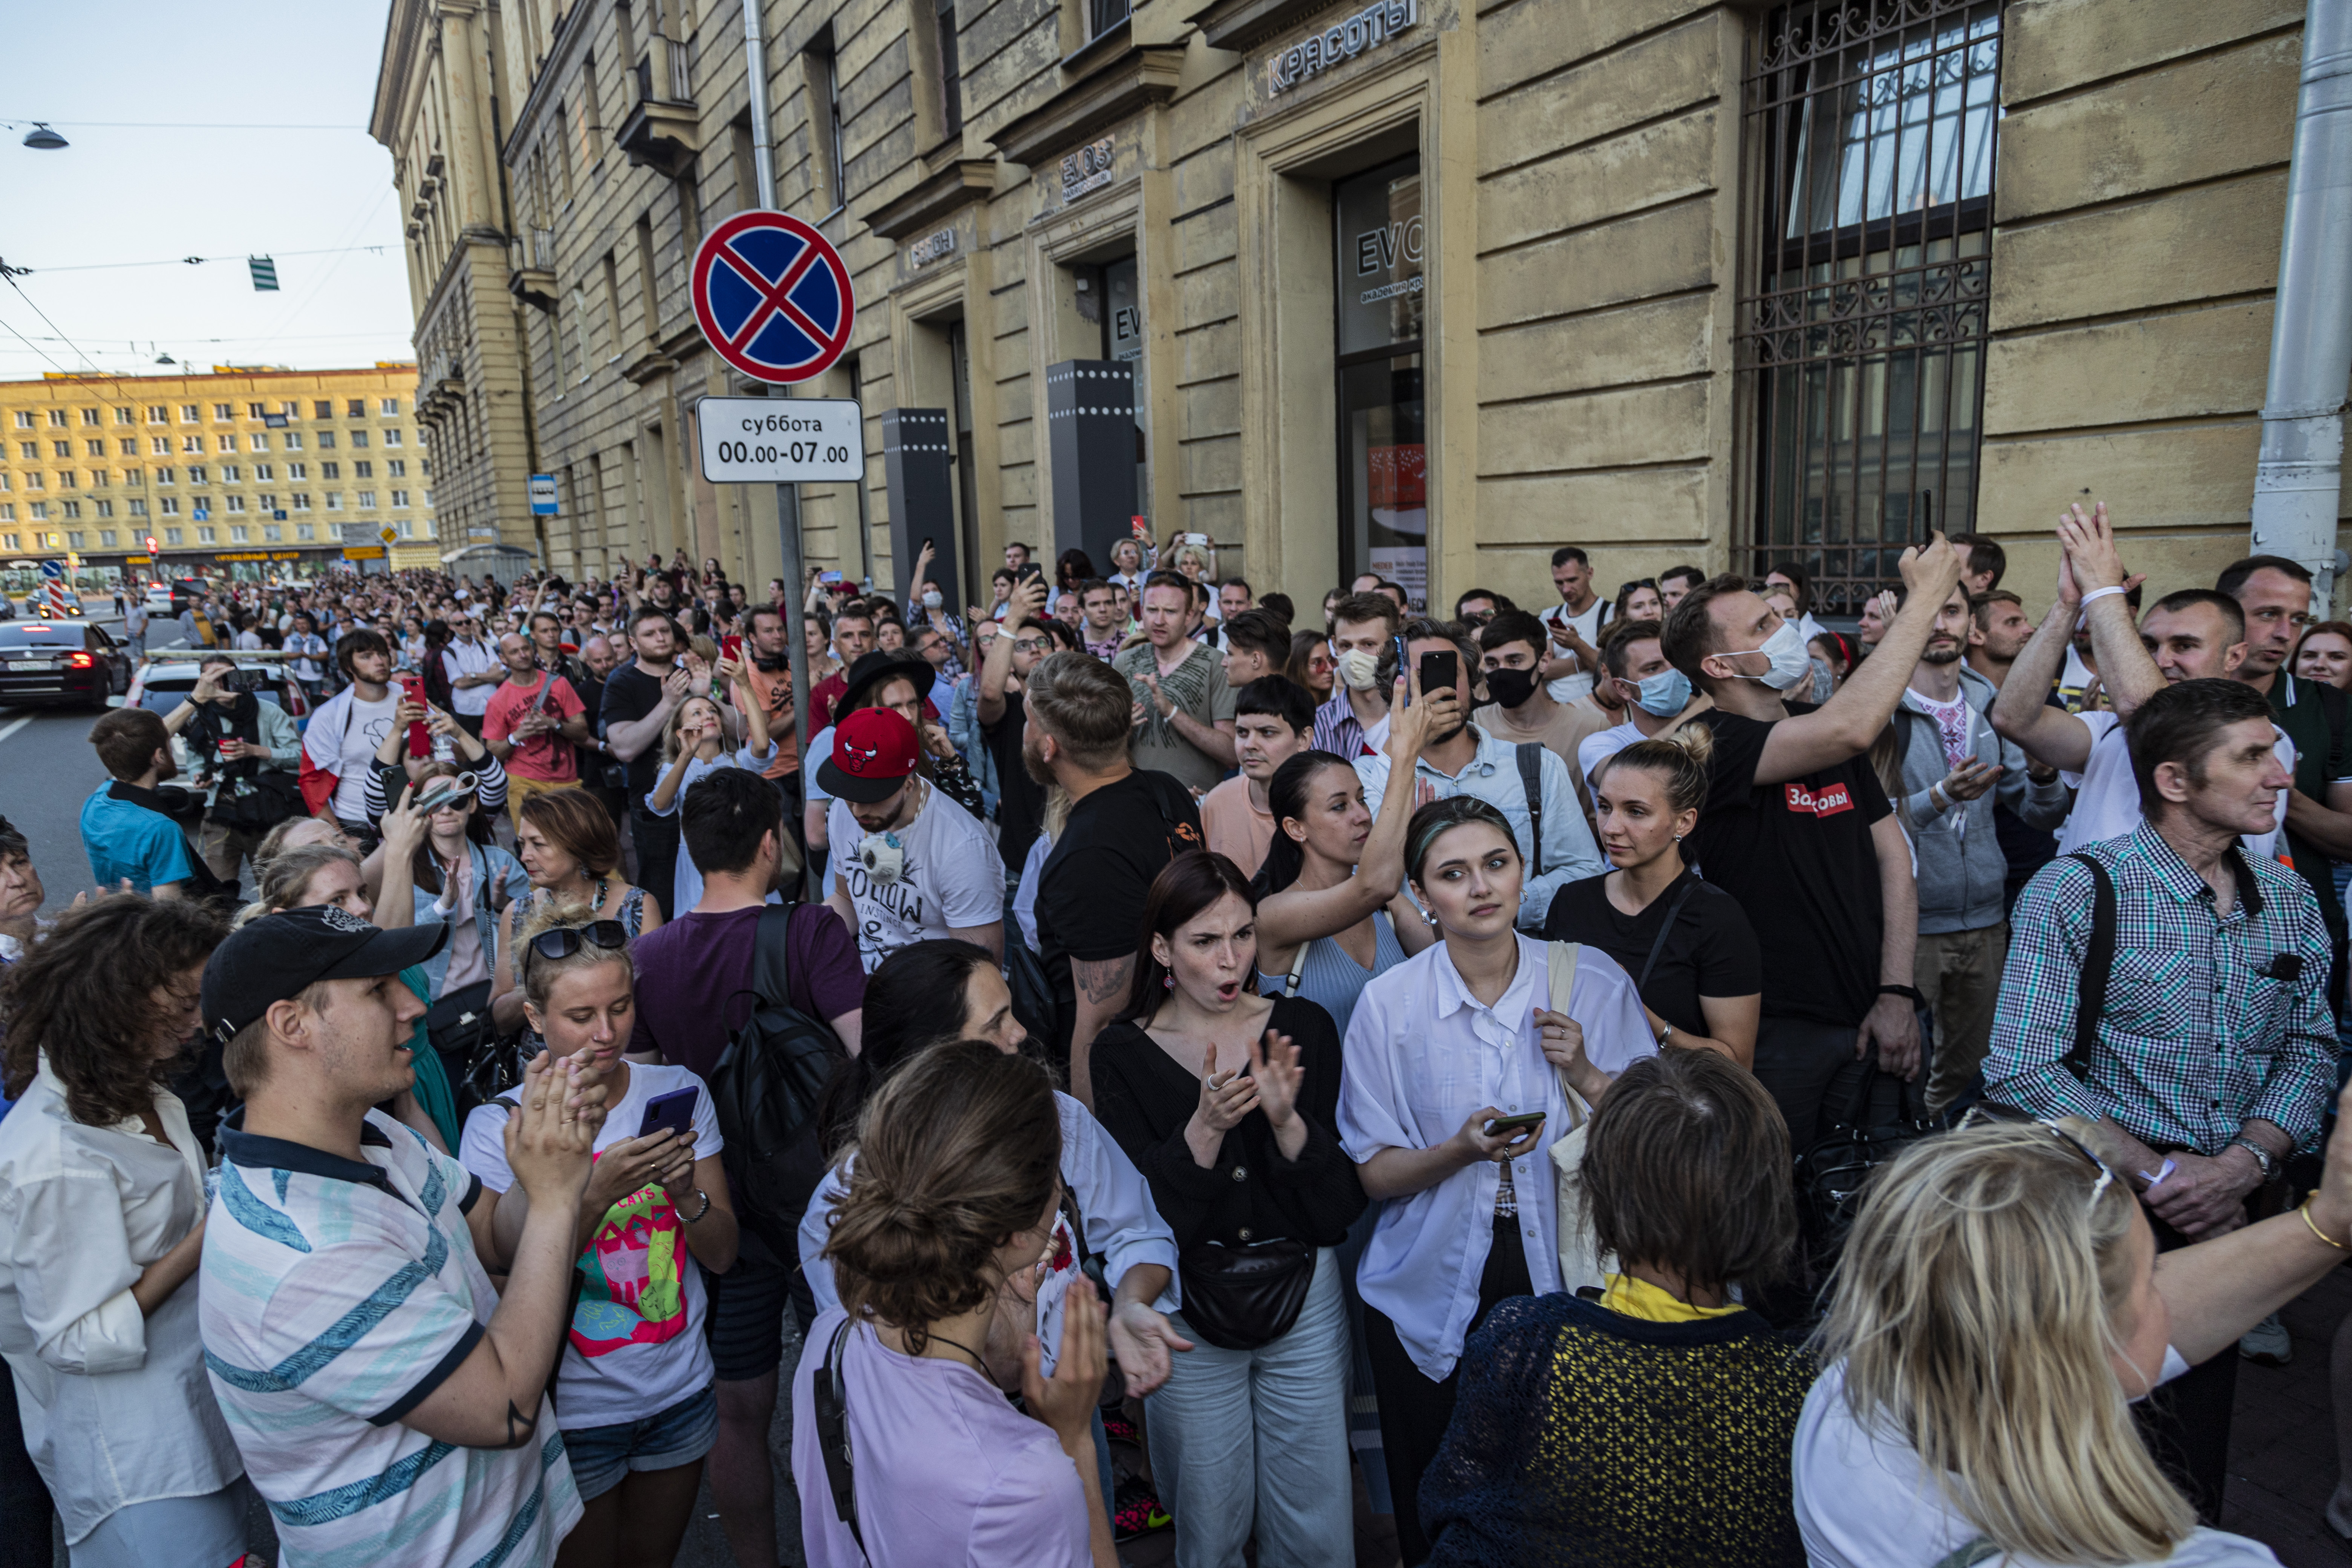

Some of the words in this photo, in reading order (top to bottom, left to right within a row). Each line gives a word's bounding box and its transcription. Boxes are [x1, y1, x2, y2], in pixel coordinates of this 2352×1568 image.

[1268, 0, 1412, 92] КРАСОТЫ
[1060, 138, 1111, 188] EVOS
[1361, 282, 1407, 303] академия
[742, 415, 822, 435] суббота
[617, 1188, 655, 1208] CATS
